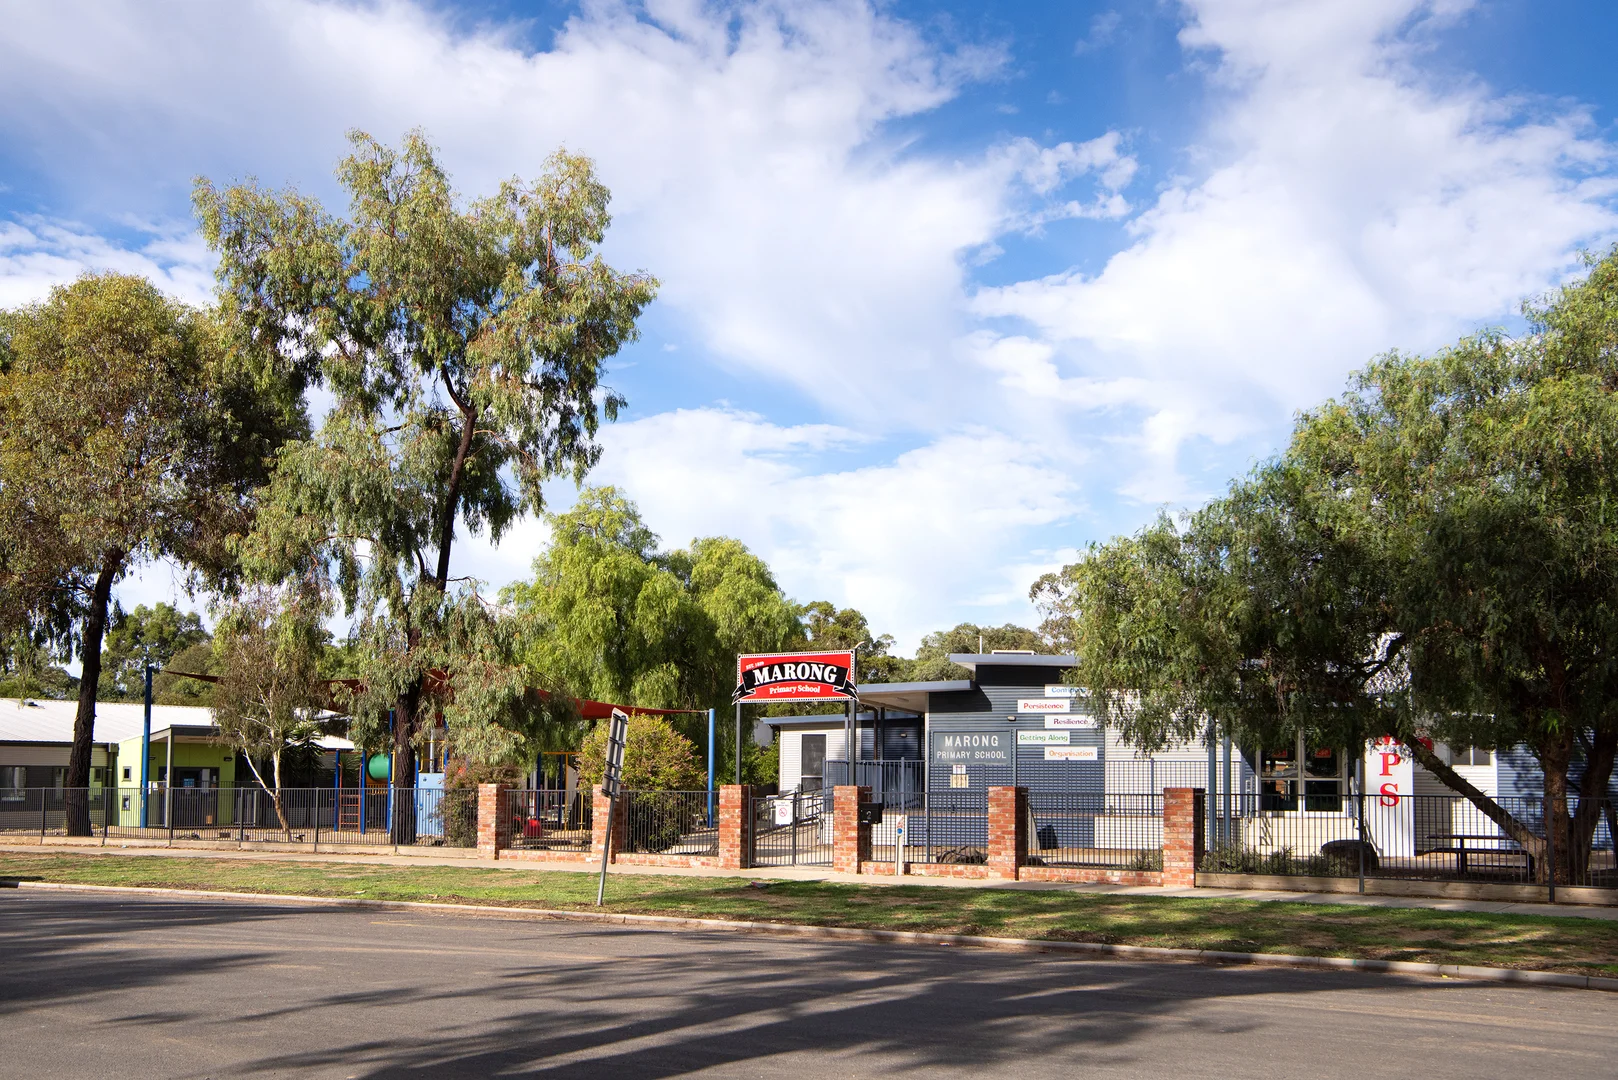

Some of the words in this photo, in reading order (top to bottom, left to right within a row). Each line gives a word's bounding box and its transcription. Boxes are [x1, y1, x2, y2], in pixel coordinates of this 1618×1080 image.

[752, 663, 837, 685] MARONG
[769, 686, 796, 694] Primary
[797, 685, 820, 693] School
[944, 735, 999, 747] MARONG
[1019, 734, 1046, 742] Getting
[1048, 734, 1068, 742] Along
[936, 750, 971, 759] PRIMARY
[975, 750, 1007, 759] SCHOOL
[1049, 750, 1094, 758] Organisation
[866, 811, 871, 819] 2
